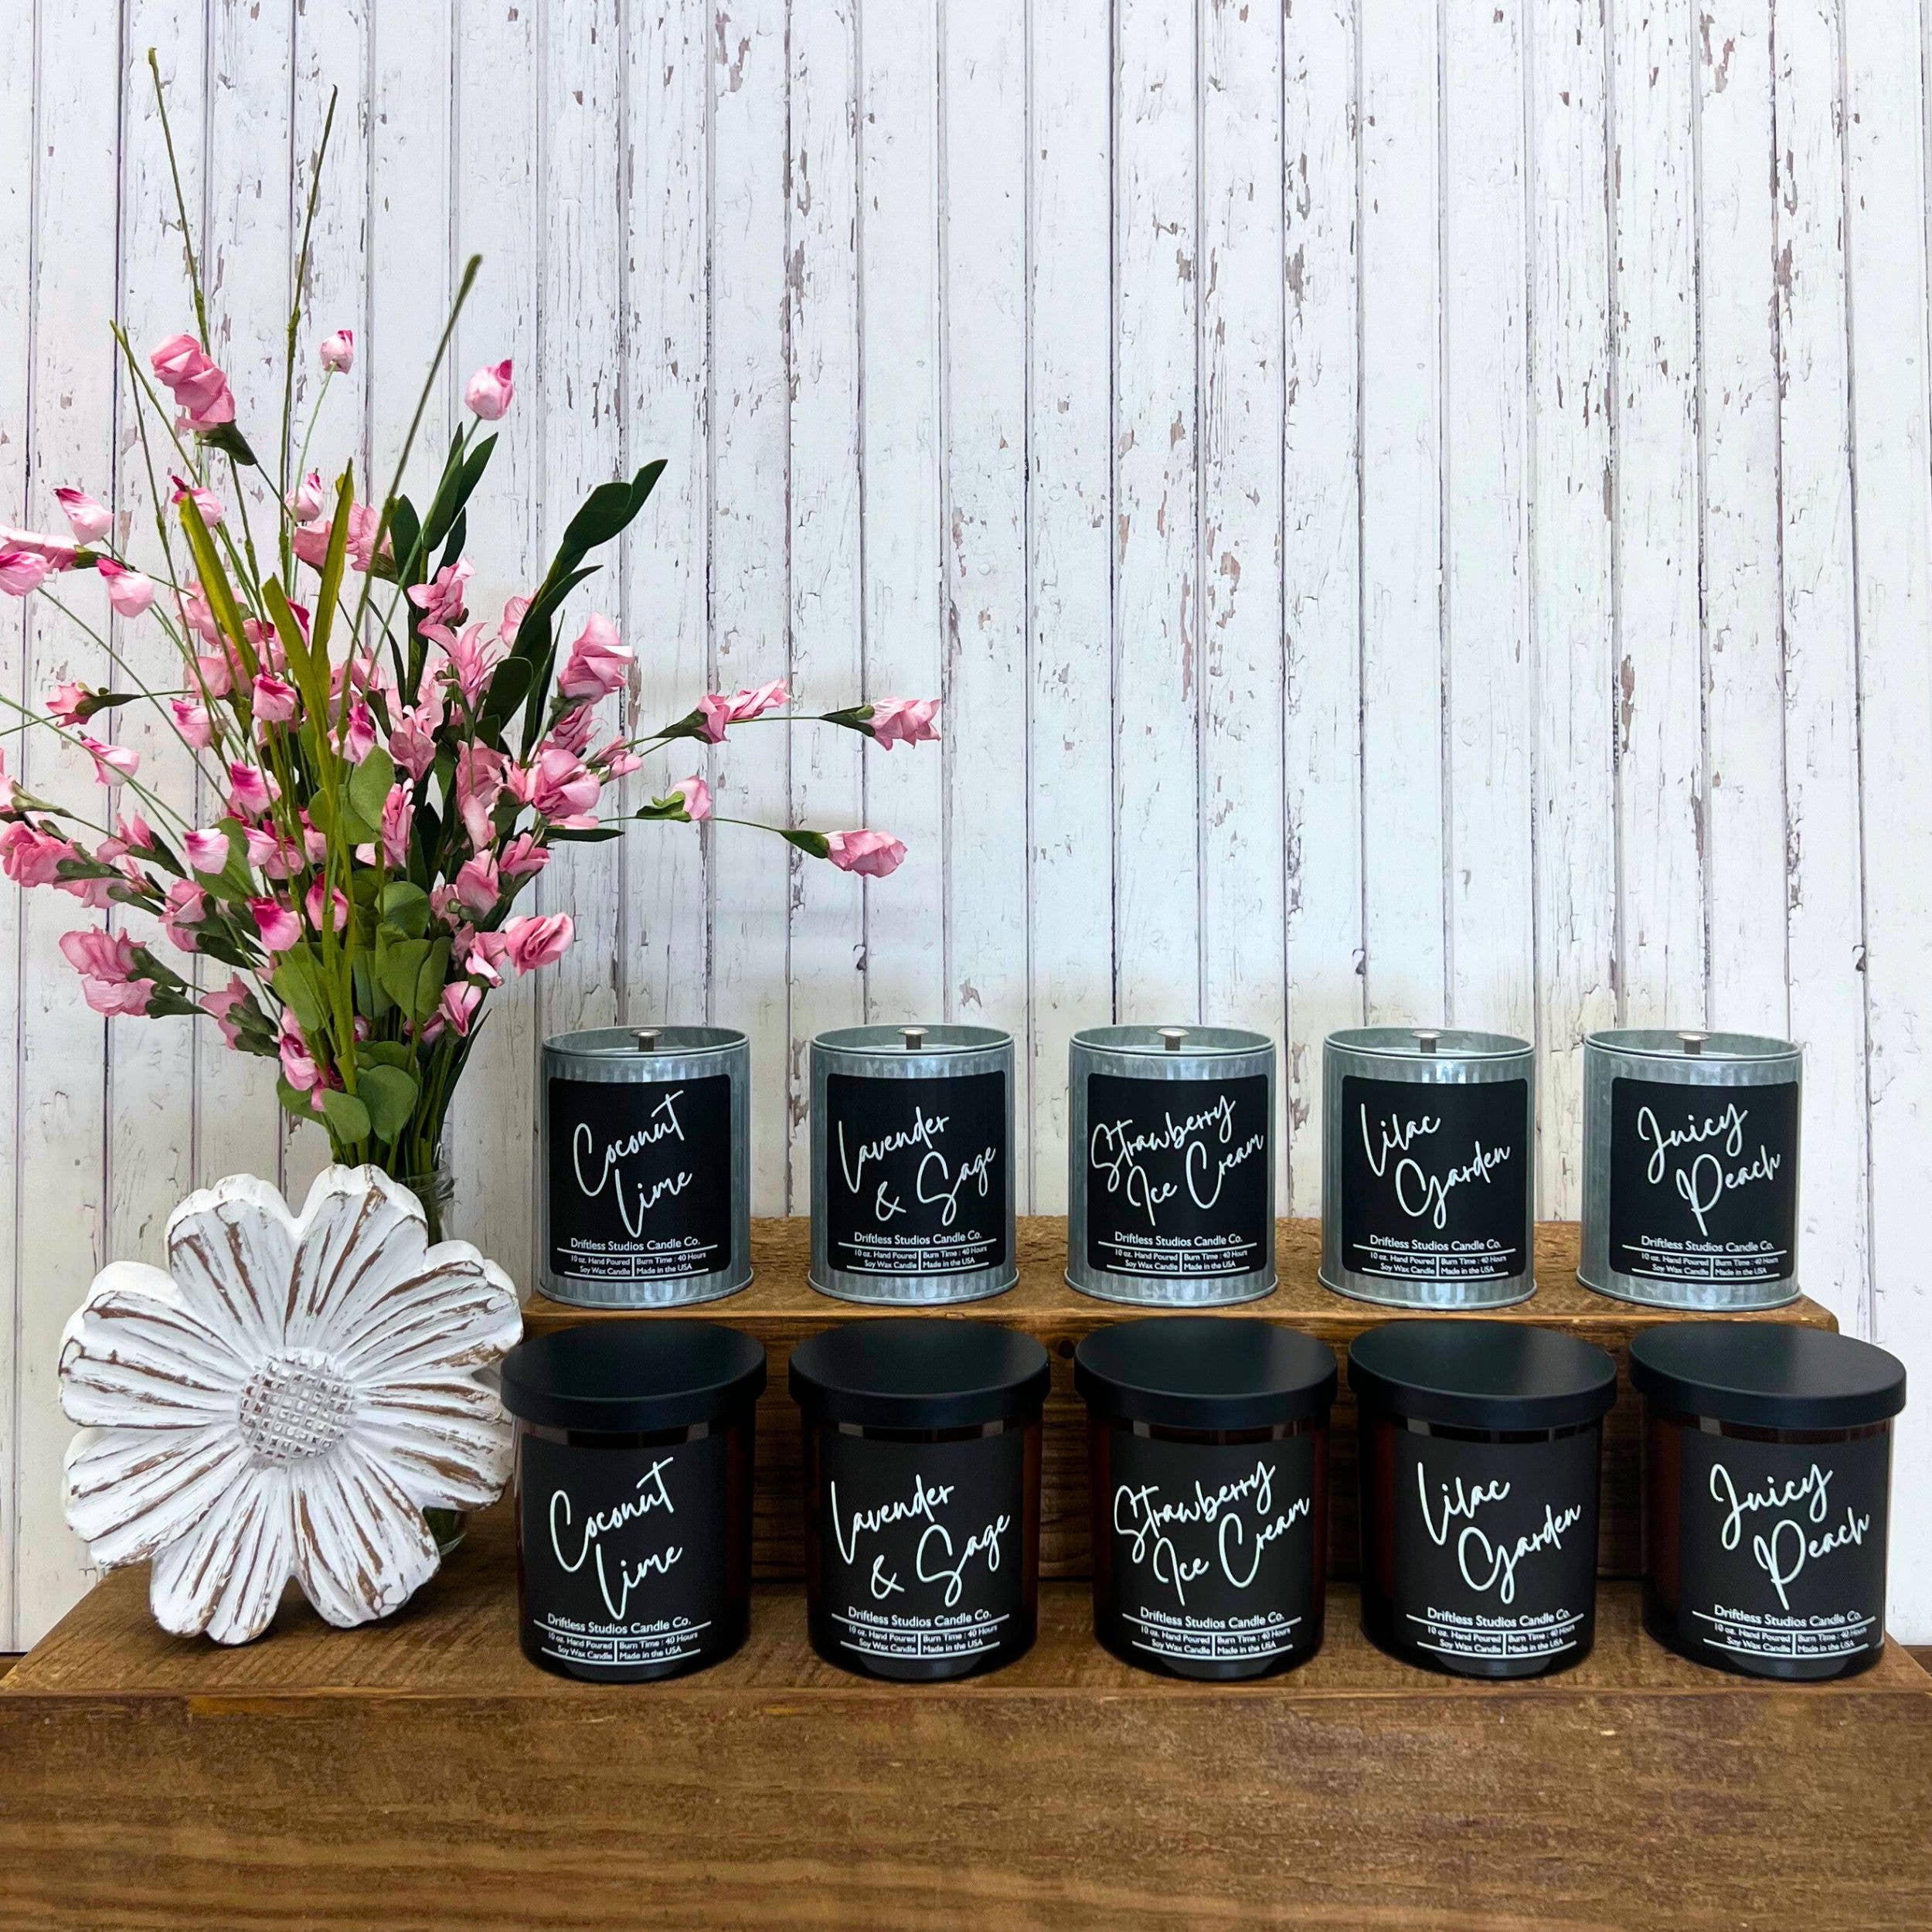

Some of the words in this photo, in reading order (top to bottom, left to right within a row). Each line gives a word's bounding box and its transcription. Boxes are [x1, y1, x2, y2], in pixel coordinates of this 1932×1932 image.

[573, 1090, 684, 1196] Coconut
[838, 1107, 949, 1193] Lavender
[1091, 1095, 1236, 1192] Strawberry
[1128, 1165, 1178, 1226] Ice
[1186, 1134, 1264, 1209] Cream
[1361, 1104, 1440, 1176] Lilac
[1638, 1103, 1748, 1184] Juicy
[614, 1169, 692, 1237] Lime
[876, 1181, 906, 1221] &
[917, 1147, 995, 1226] Sage
[1396, 1141, 1510, 1230] Garden
[1676, 1145, 1781, 1236] Peach
[571, 1238, 605, 1250] Driftless
[608, 1241, 644, 1251] Studios
[648, 1240, 681, 1249] Candle
[855, 1232, 892, 1244] Driftless
[895, 1235, 930, 1245] Studios
[934, 1233, 965, 1243] Candle
[1115, 1231, 1153, 1245] Driftless
[1155, 1236, 1192, 1247] Studios
[1194, 1235, 1226, 1247] Candle
[1370, 1235, 1409, 1249] Driftless
[1412, 1240, 1449, 1251] Studios
[1451, 1240, 1484, 1251] Candle
[1641, 1236, 1683, 1250] Driftless
[1685, 1241, 1723, 1252] Studios
[1726, 1242, 1758, 1252] Candle
[550, 1457, 674, 1572] Coconut
[832, 1475, 954, 1565] Lavender
[1114, 1461, 1275, 1564] Strawberry
[1418, 1462, 1510, 1546] Lilac
[1710, 1464, 1833, 1550] Juicy
[596, 1543, 682, 1620] Lime
[871, 1555, 905, 1599] &
[917, 1515, 1010, 1607] Sage
[1153, 1537, 1209, 1606] Ice
[1219, 1498, 1309, 1588] Cream
[1458, 1505, 1581, 1604] Garden
[1754, 1507, 1869, 1611] Peach
[548, 1613, 585, 1632] Driftless
[588, 1622, 628, 1634] Studios
[631, 1622, 669, 1634] Candle
[849, 1606, 888, 1624] Driftless
[892, 1615, 930, 1628] Studios
[935, 1614, 971, 1626] Candle
[1141, 1607, 1182, 1626] Driftless
[1185, 1616, 1226, 1629] Studios
[1229, 1616, 1265, 1628] Candle
[1427, 1607, 1473, 1626] Driftless
[1476, 1615, 1516, 1628] Studios
[1519, 1613, 1554, 1627] Candle
[1714, 1604, 1761, 1624] Driftless
[1765, 1614, 1807, 1628] Studios
[1809, 1615, 1845, 1626] Candle
